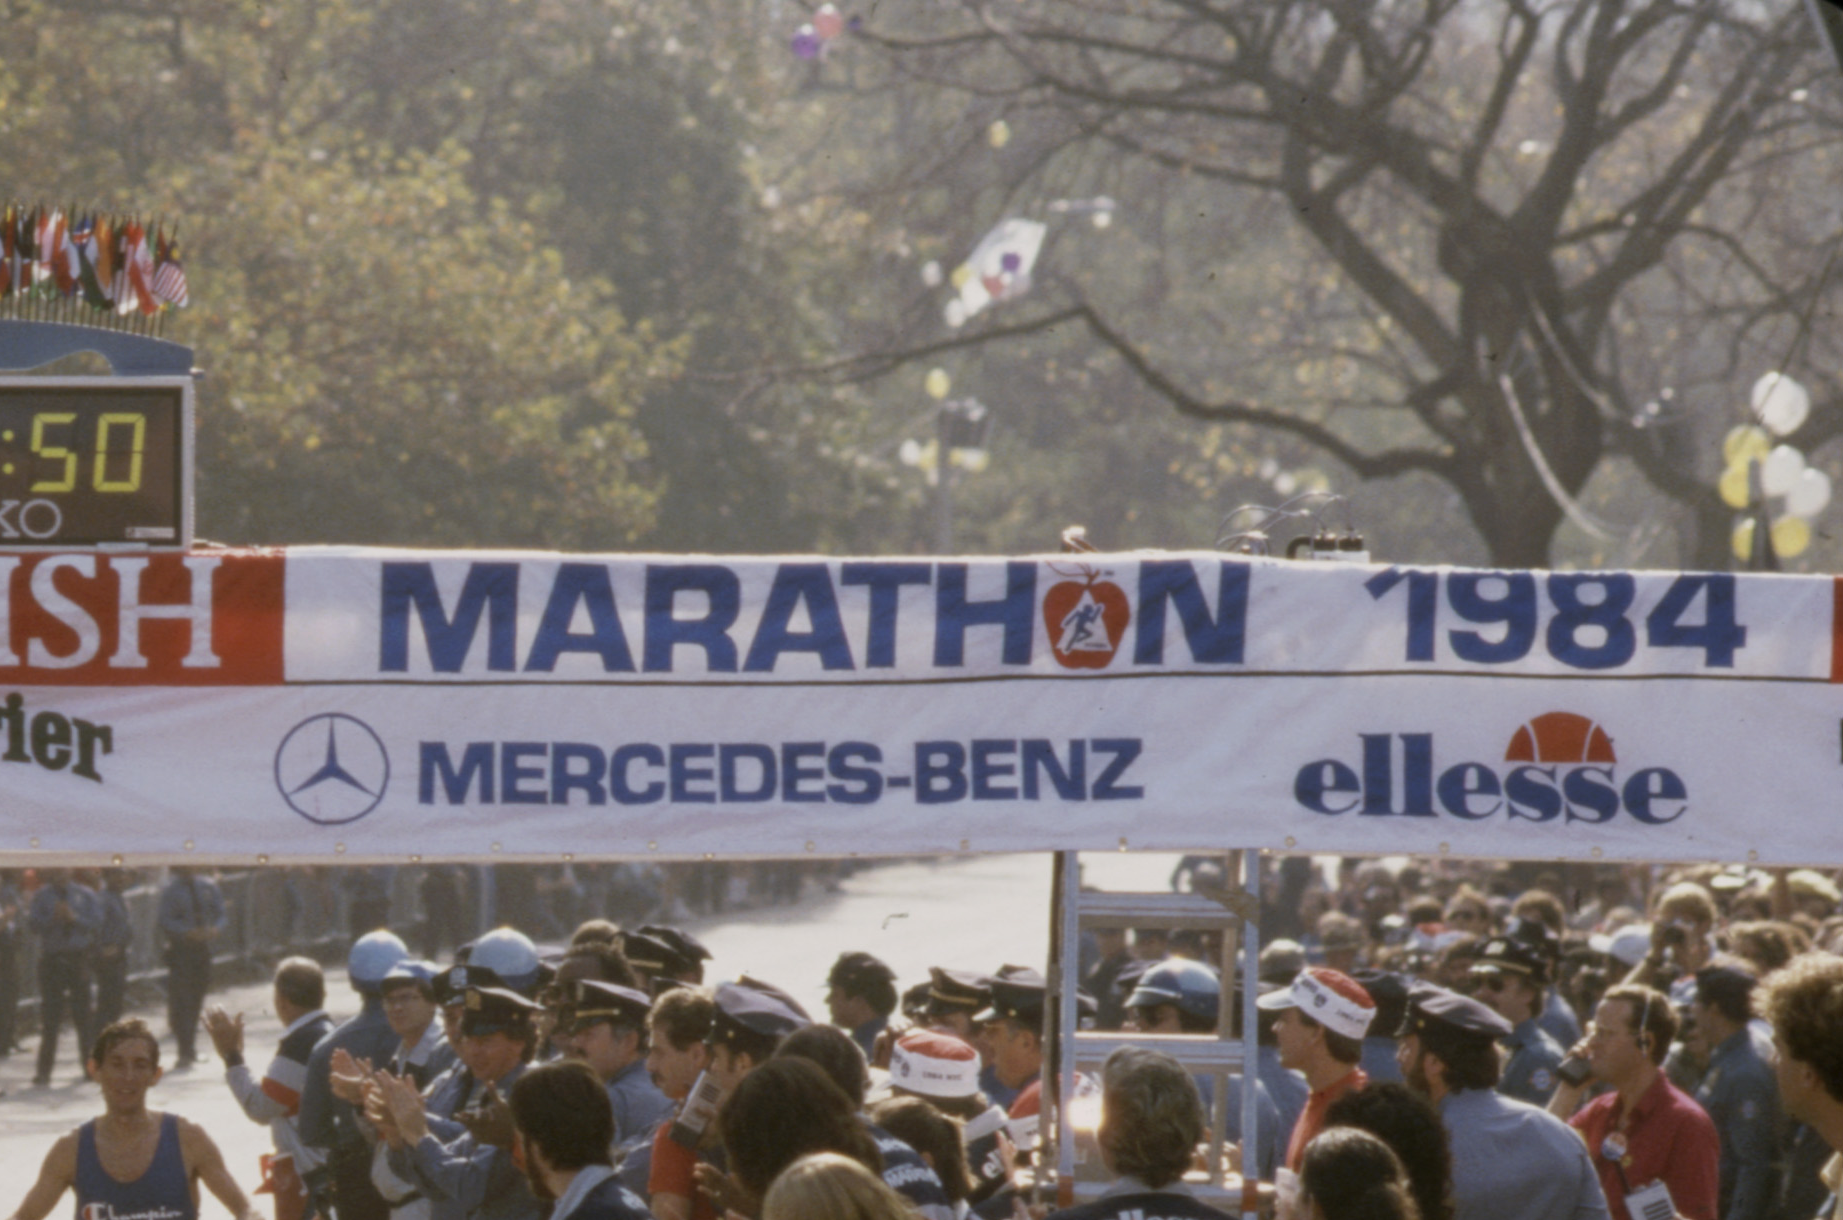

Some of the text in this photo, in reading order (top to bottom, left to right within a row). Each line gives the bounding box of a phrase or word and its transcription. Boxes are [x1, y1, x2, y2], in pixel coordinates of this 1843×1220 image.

[1364, 567, 1748, 670] 1984
[417, 737, 1145, 806] MERCEDES-BENZ
[1294, 732, 1689, 825] ellesse
